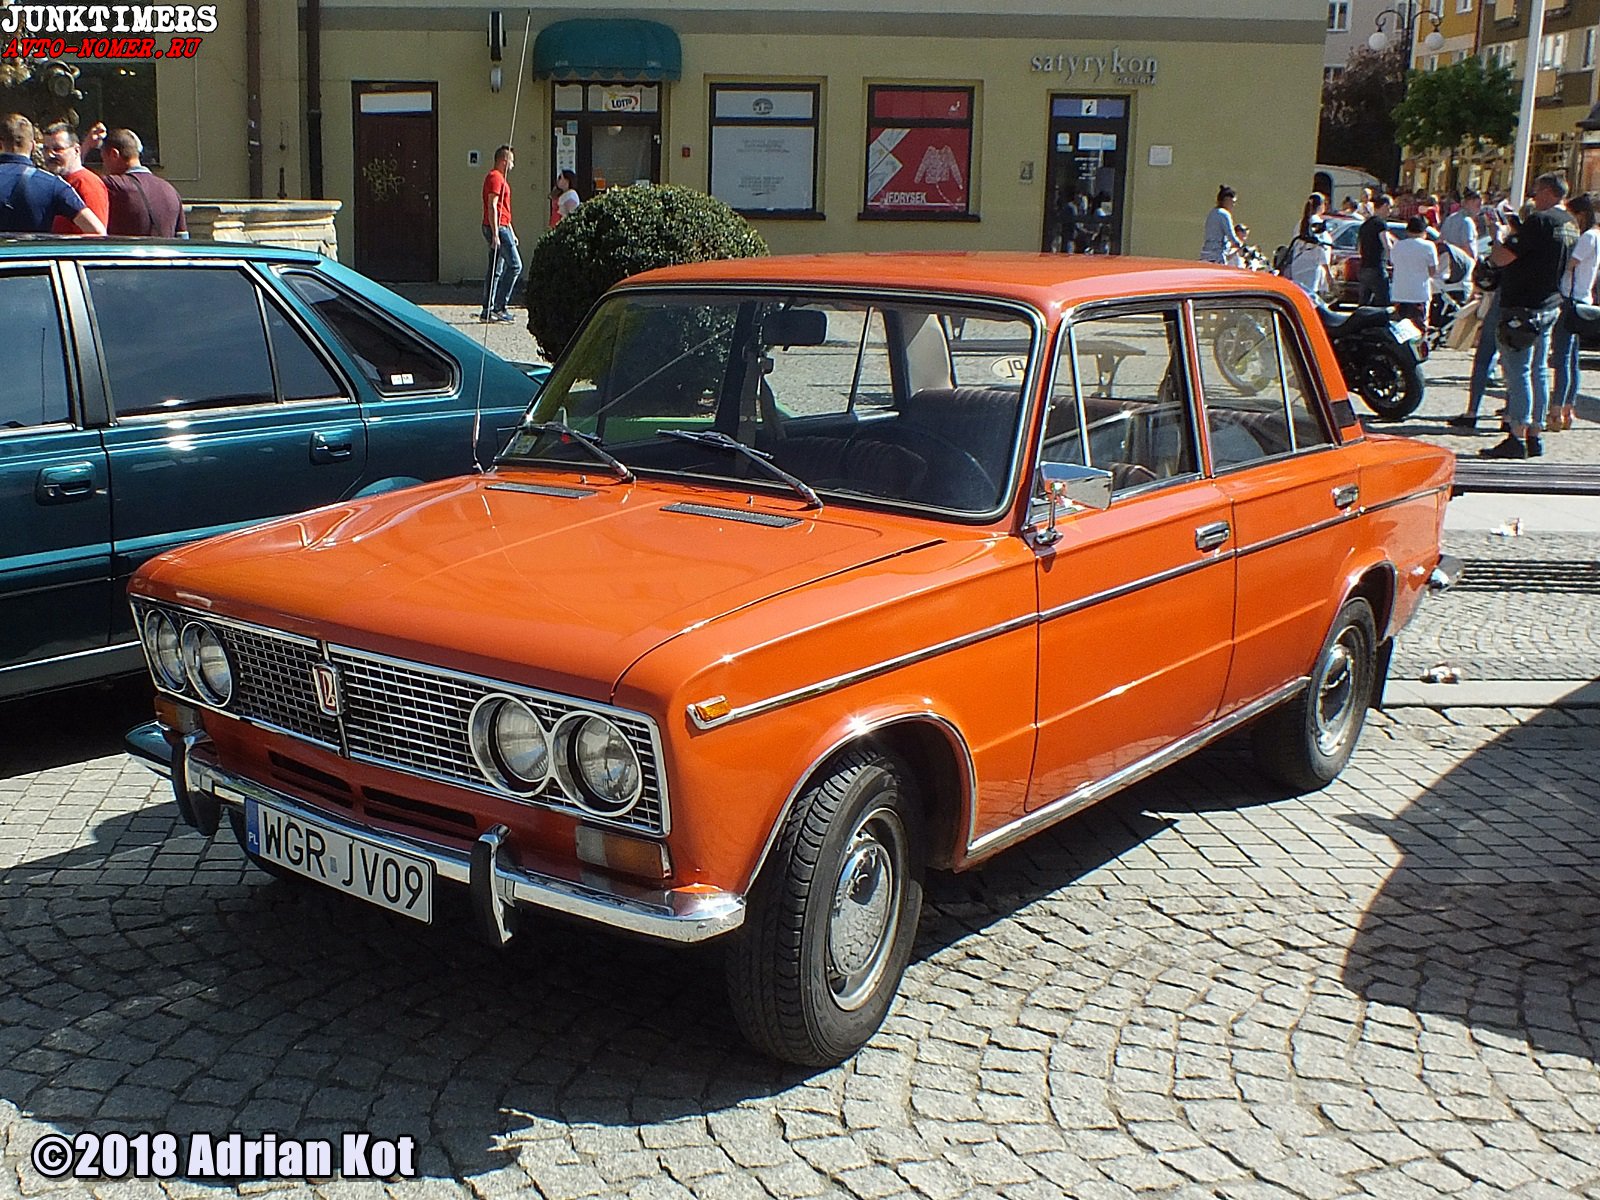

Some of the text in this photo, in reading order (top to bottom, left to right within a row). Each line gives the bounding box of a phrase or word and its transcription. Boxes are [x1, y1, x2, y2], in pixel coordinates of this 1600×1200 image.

[1031, 46, 1158, 82] satyrykon
[611, 98, 633, 109] LOTTO
[248, 831, 259, 846] PL
[263, 811, 423, 910] WGR JV09
